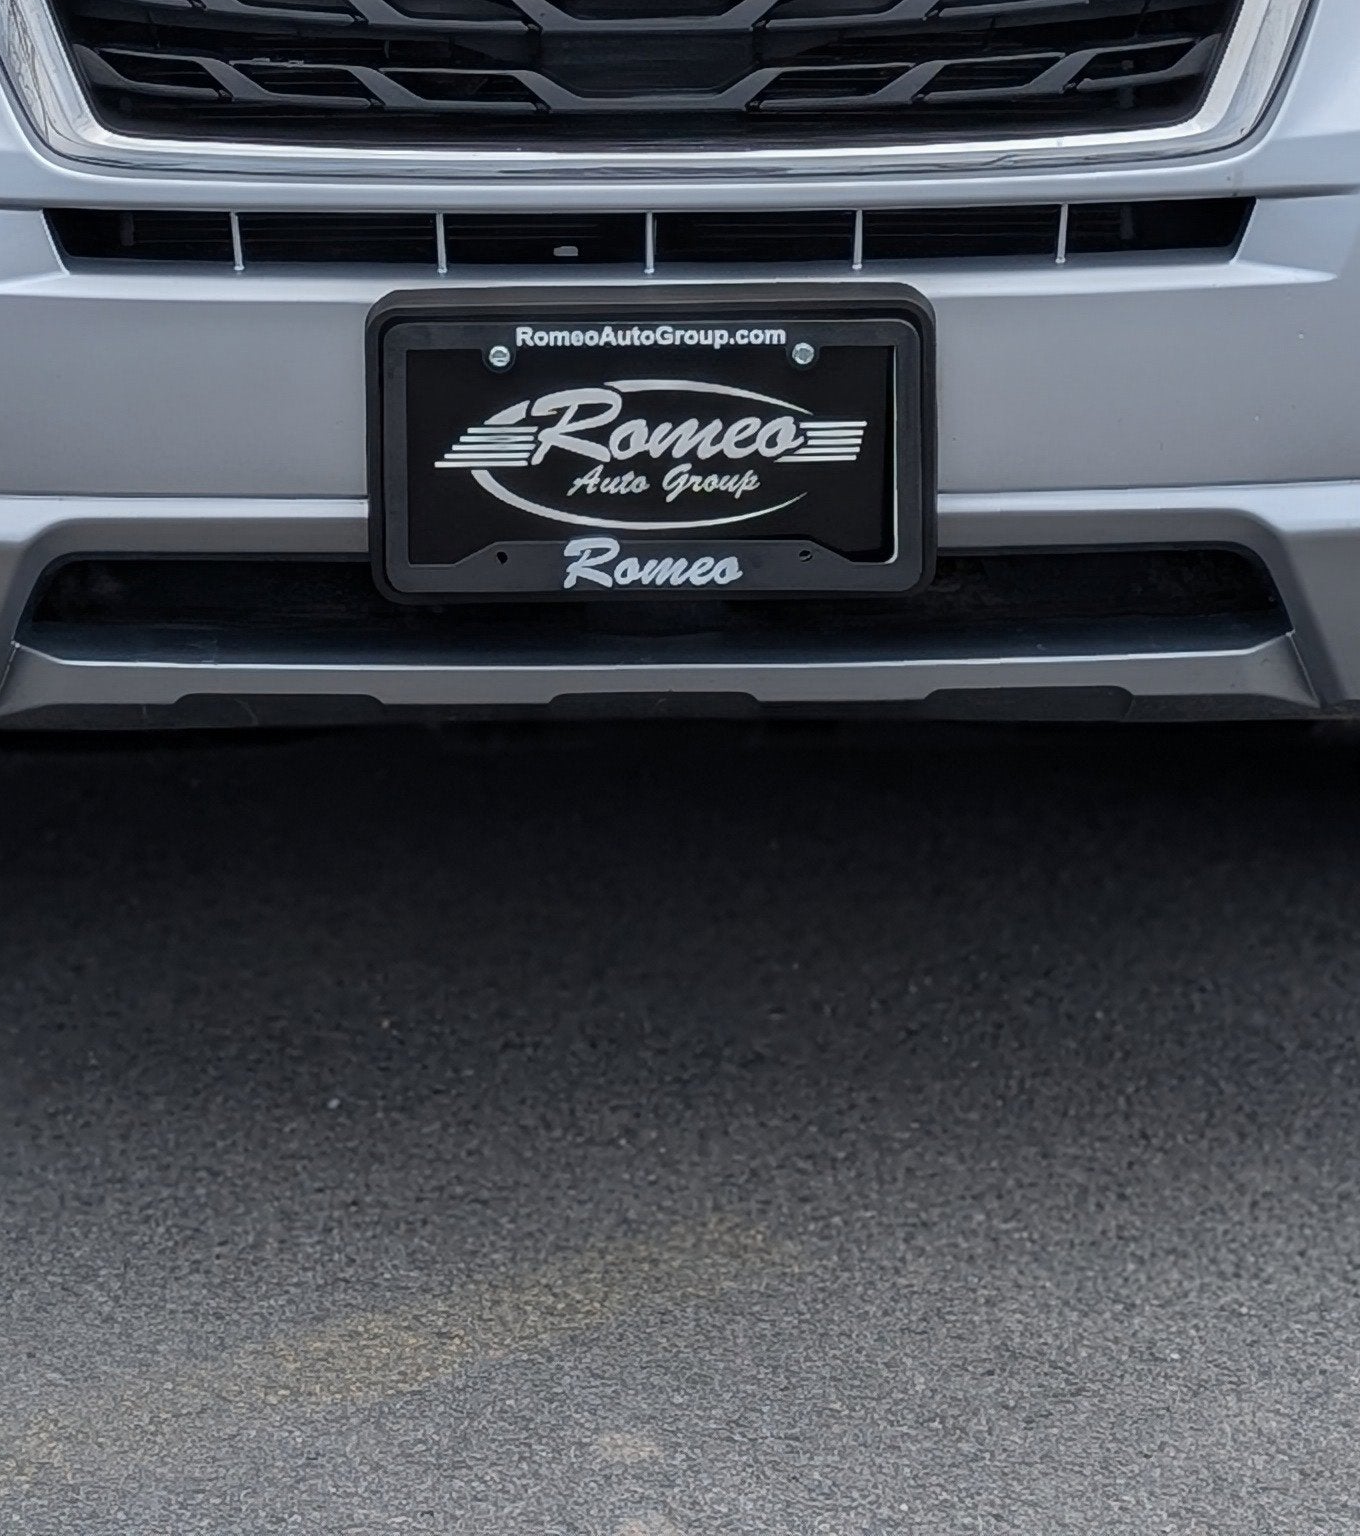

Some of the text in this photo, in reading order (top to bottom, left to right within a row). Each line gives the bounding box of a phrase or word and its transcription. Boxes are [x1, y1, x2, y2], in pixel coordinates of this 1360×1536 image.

[515, 326, 787, 349] RomeoAutoGroup.com
[531, 387, 805, 466] Romeo
[566, 463, 761, 503] Auto Group
[563, 537, 743, 589] Romeo
